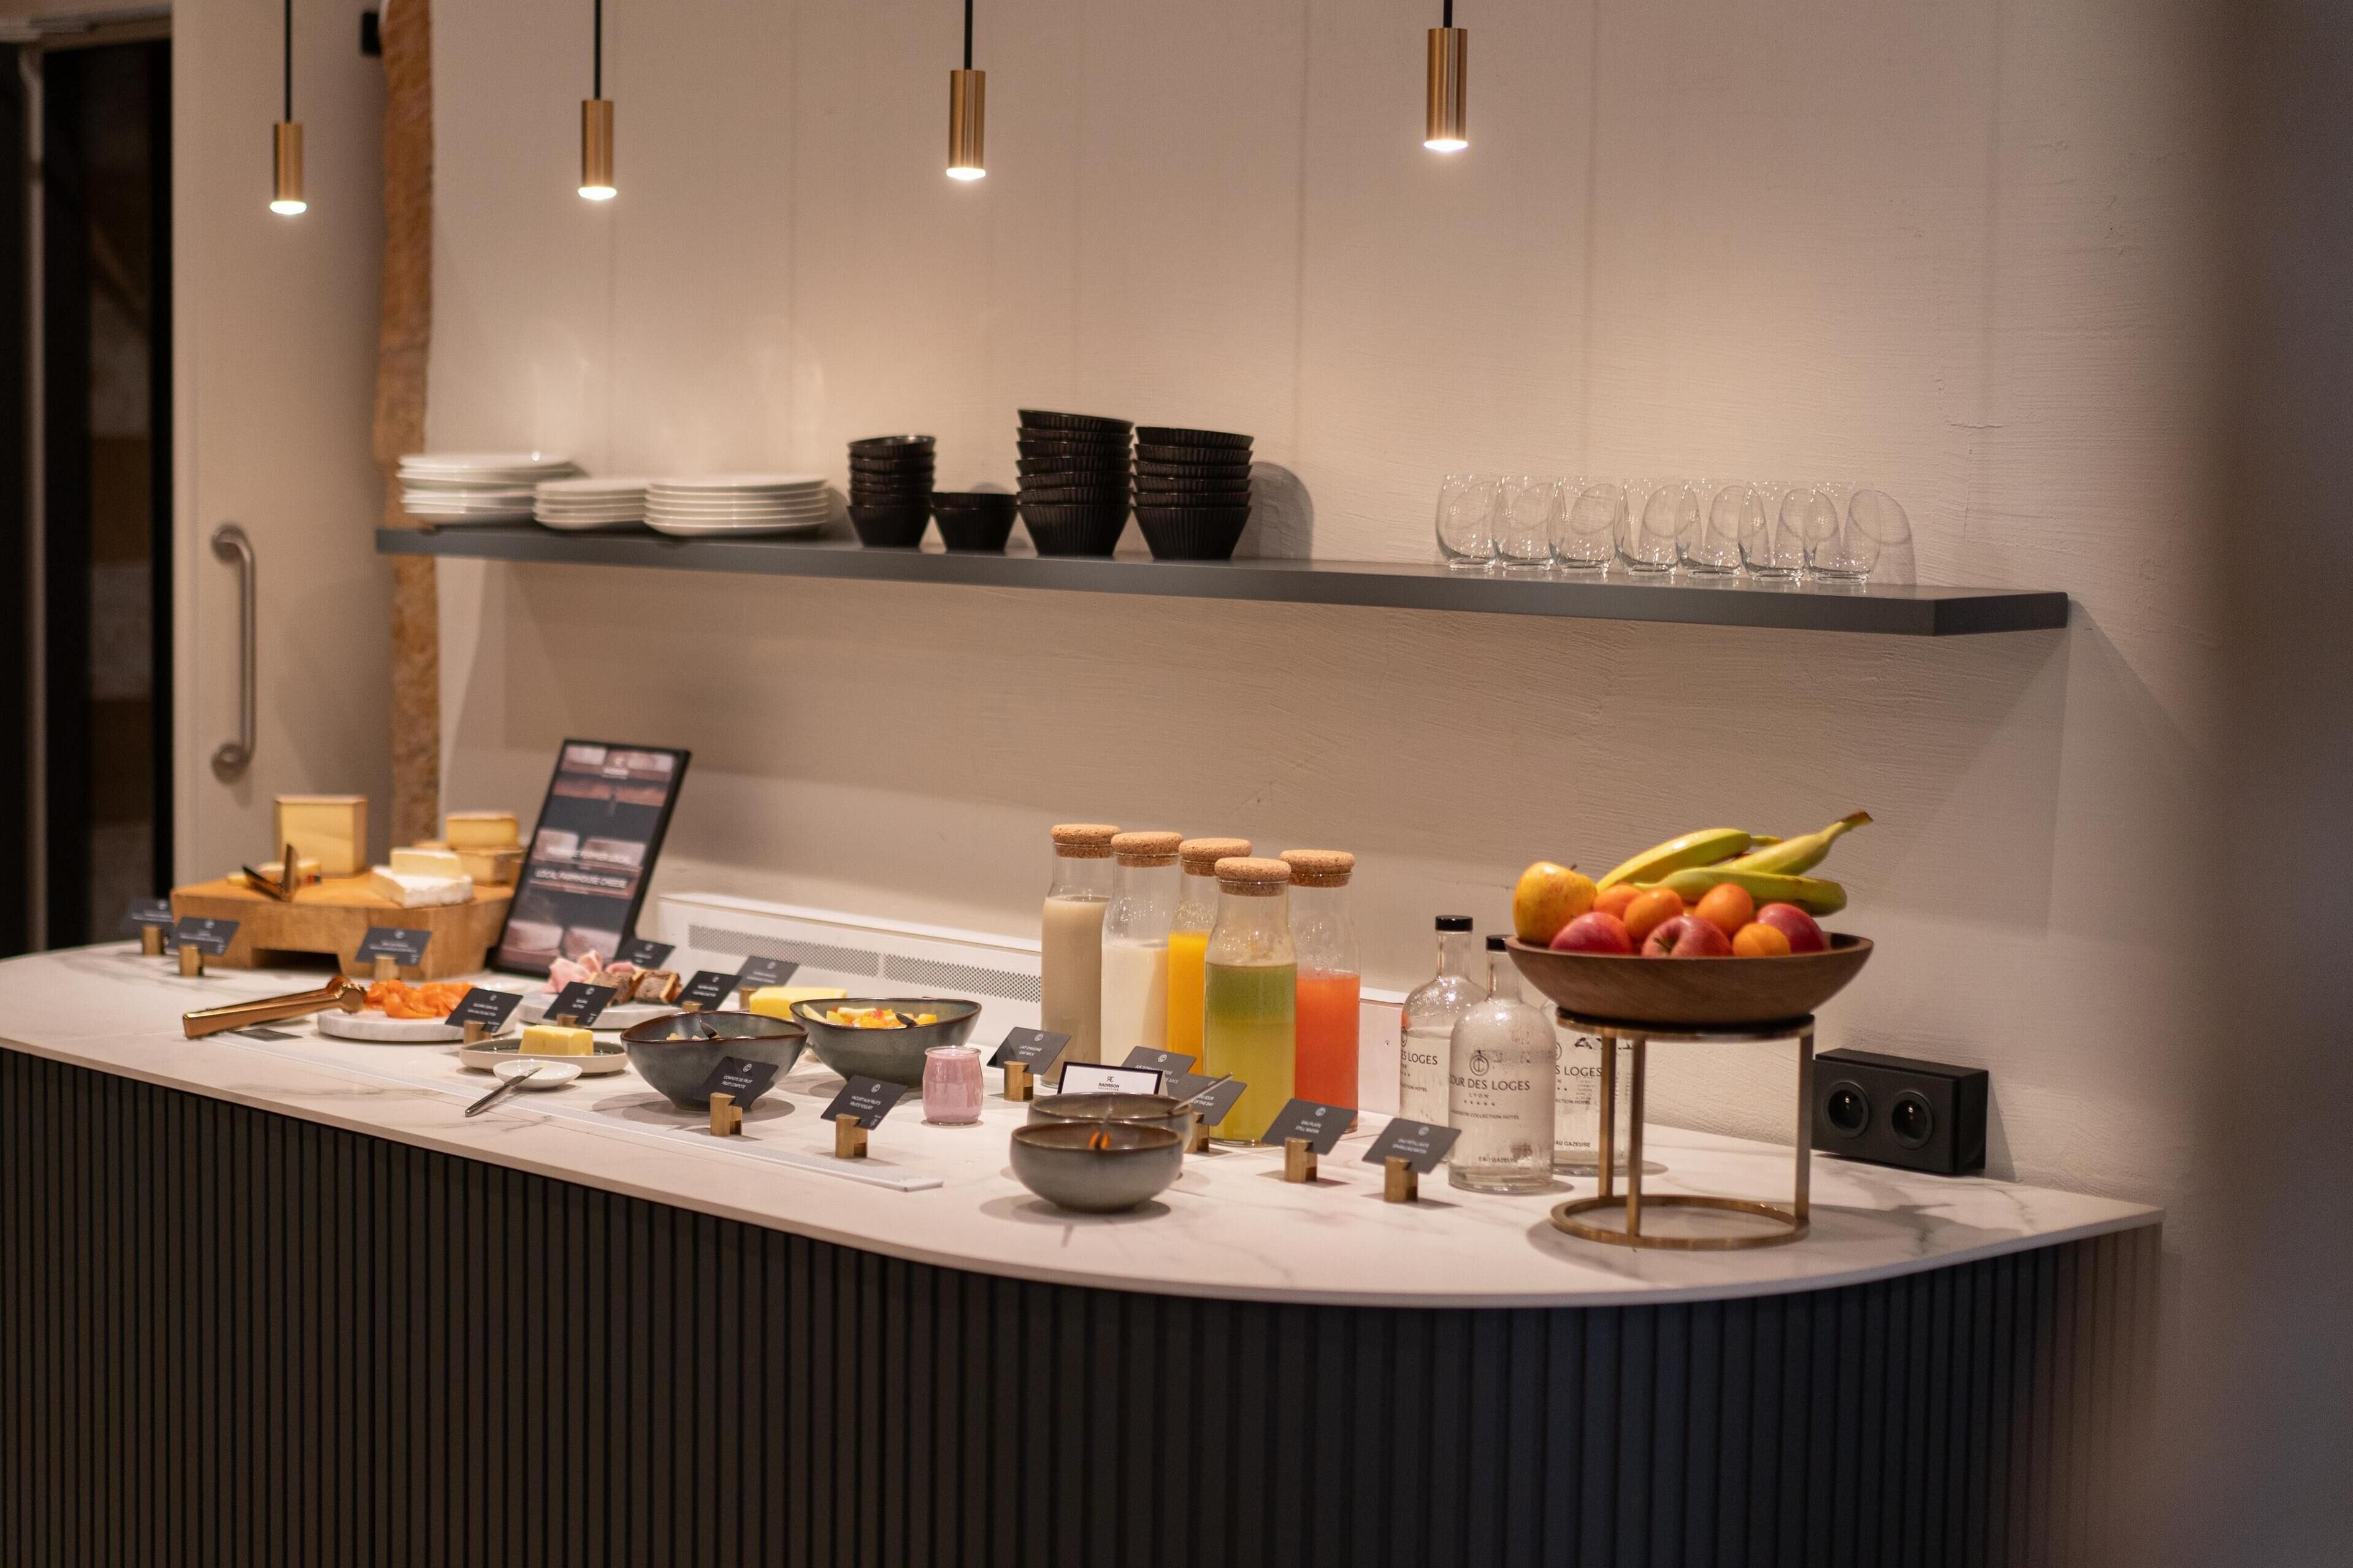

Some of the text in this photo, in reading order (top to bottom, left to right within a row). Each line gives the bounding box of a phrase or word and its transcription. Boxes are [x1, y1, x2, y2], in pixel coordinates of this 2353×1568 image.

[1408, 1052, 1438, 1065] LOGES
[1564, 1066, 1604, 1077] LOGES
[1468, 1079, 1488, 1090] DES
[1491, 1080, 1531, 1091] LOGES
